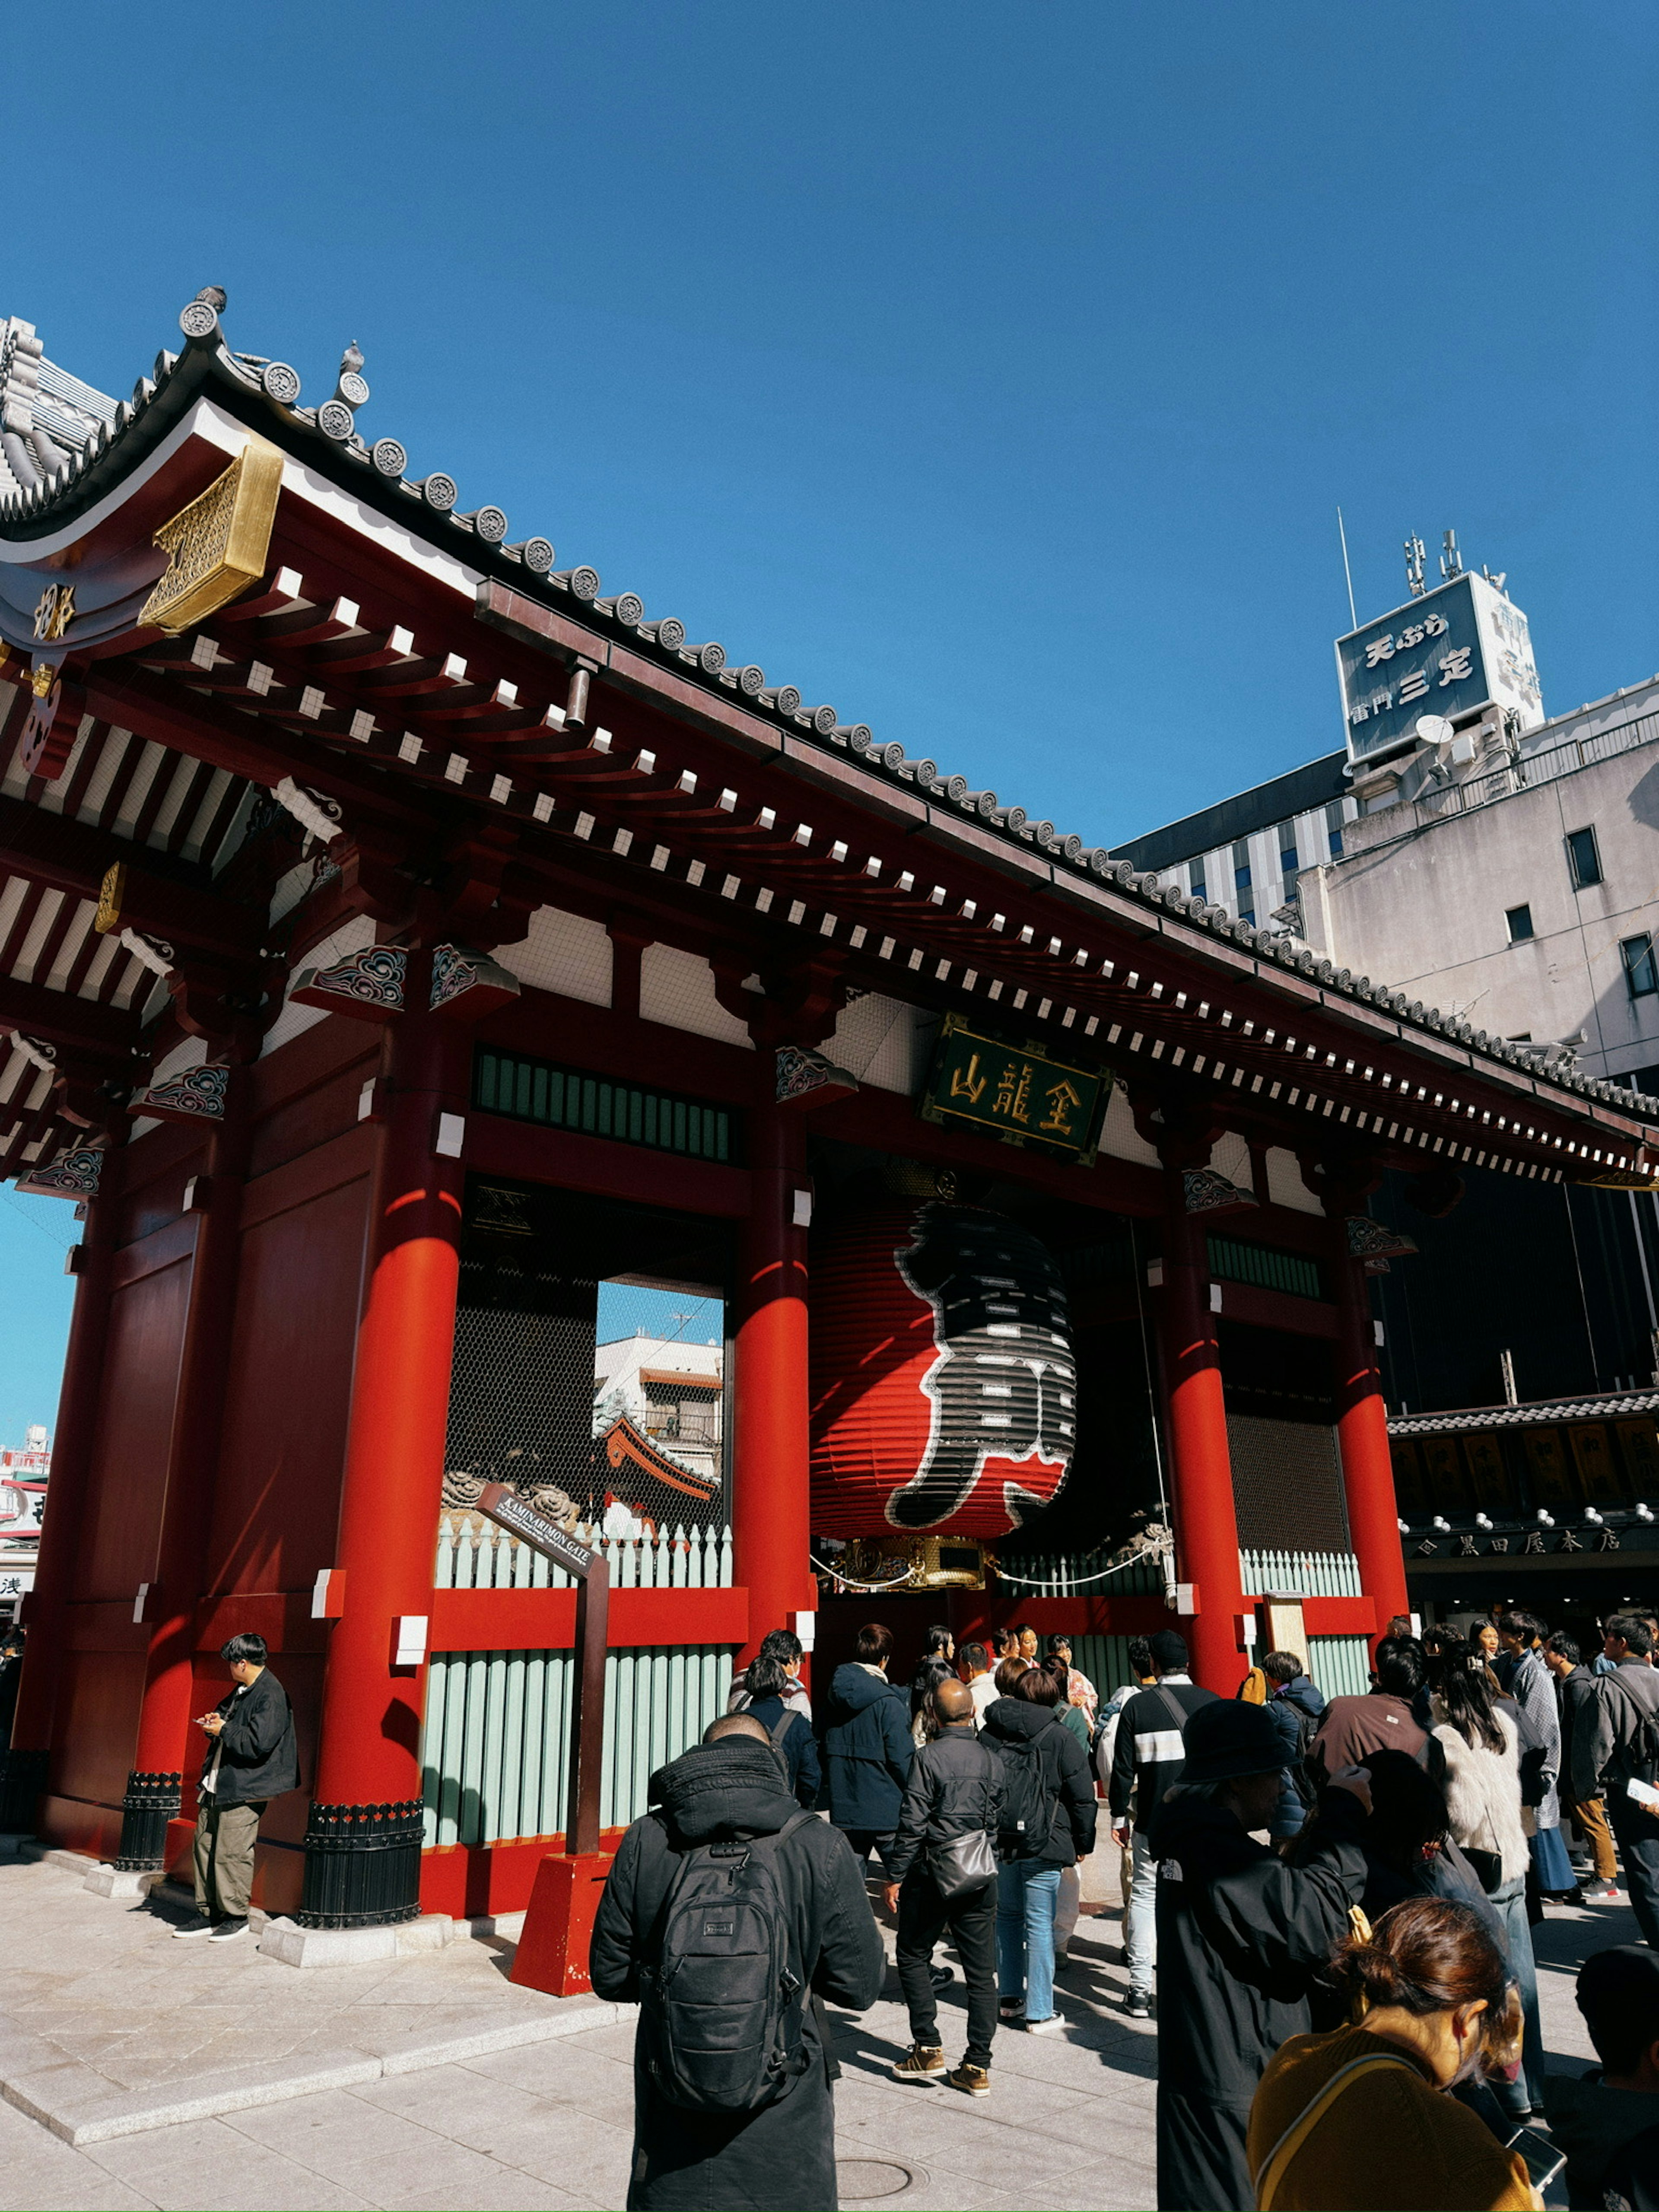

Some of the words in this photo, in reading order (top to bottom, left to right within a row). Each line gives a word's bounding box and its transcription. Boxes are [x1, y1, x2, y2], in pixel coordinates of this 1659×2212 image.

[1365, 613, 1449, 668] 天ぷら
[1350, 692, 1393, 725] 雷門
[1399, 646, 1473, 705] 三定
[504, 1497, 569, 1545] KAMINARIMON
[566, 1540, 591, 1561] GATE
[1460, 1527, 1621, 1556] 黒田屋本店
